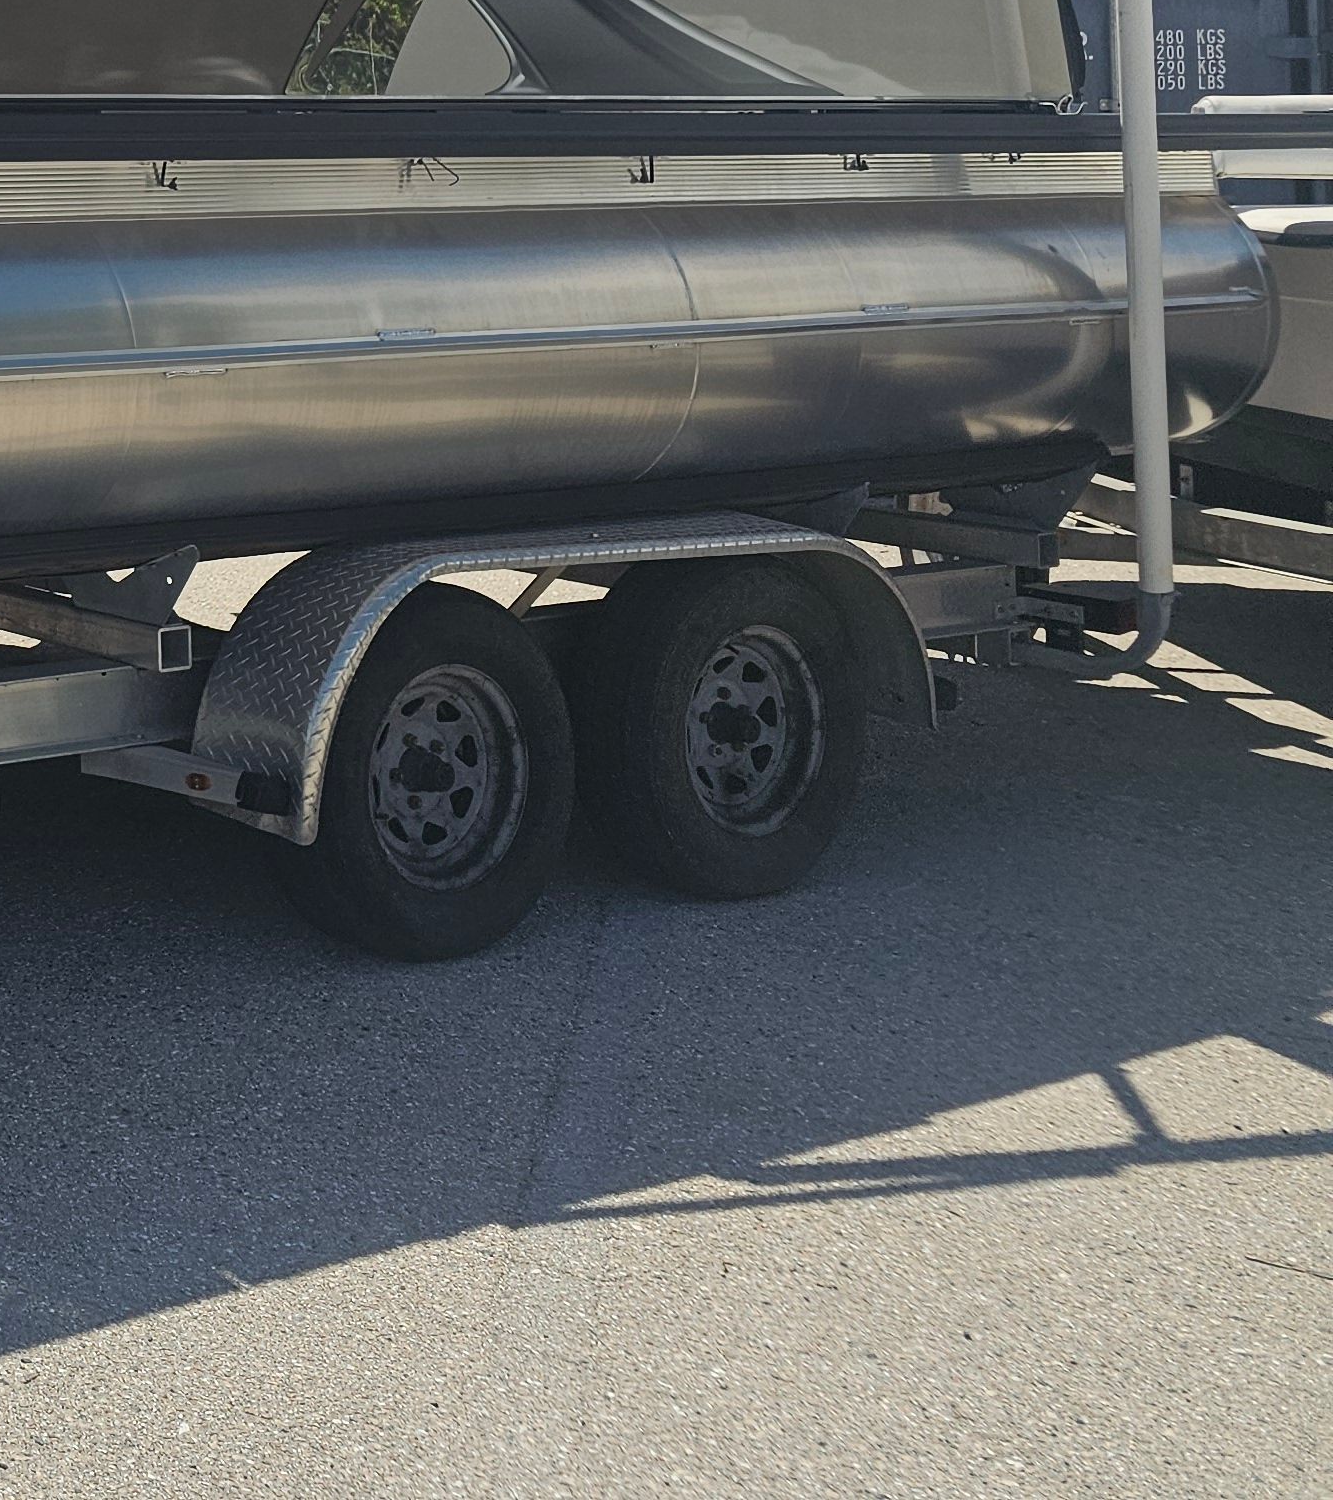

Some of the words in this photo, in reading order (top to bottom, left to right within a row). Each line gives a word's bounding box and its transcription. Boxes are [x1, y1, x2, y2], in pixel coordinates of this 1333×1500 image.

[1196, 28, 1226, 45] KGS
[1156, 44, 1185, 60] 200
[1197, 44, 1224, 60] LBS
[1156, 60, 1186, 75] 290
[1197, 59, 1227, 75] KGS
[1157, 75, 1186, 91] 050
[1198, 74, 1225, 90] LBS
